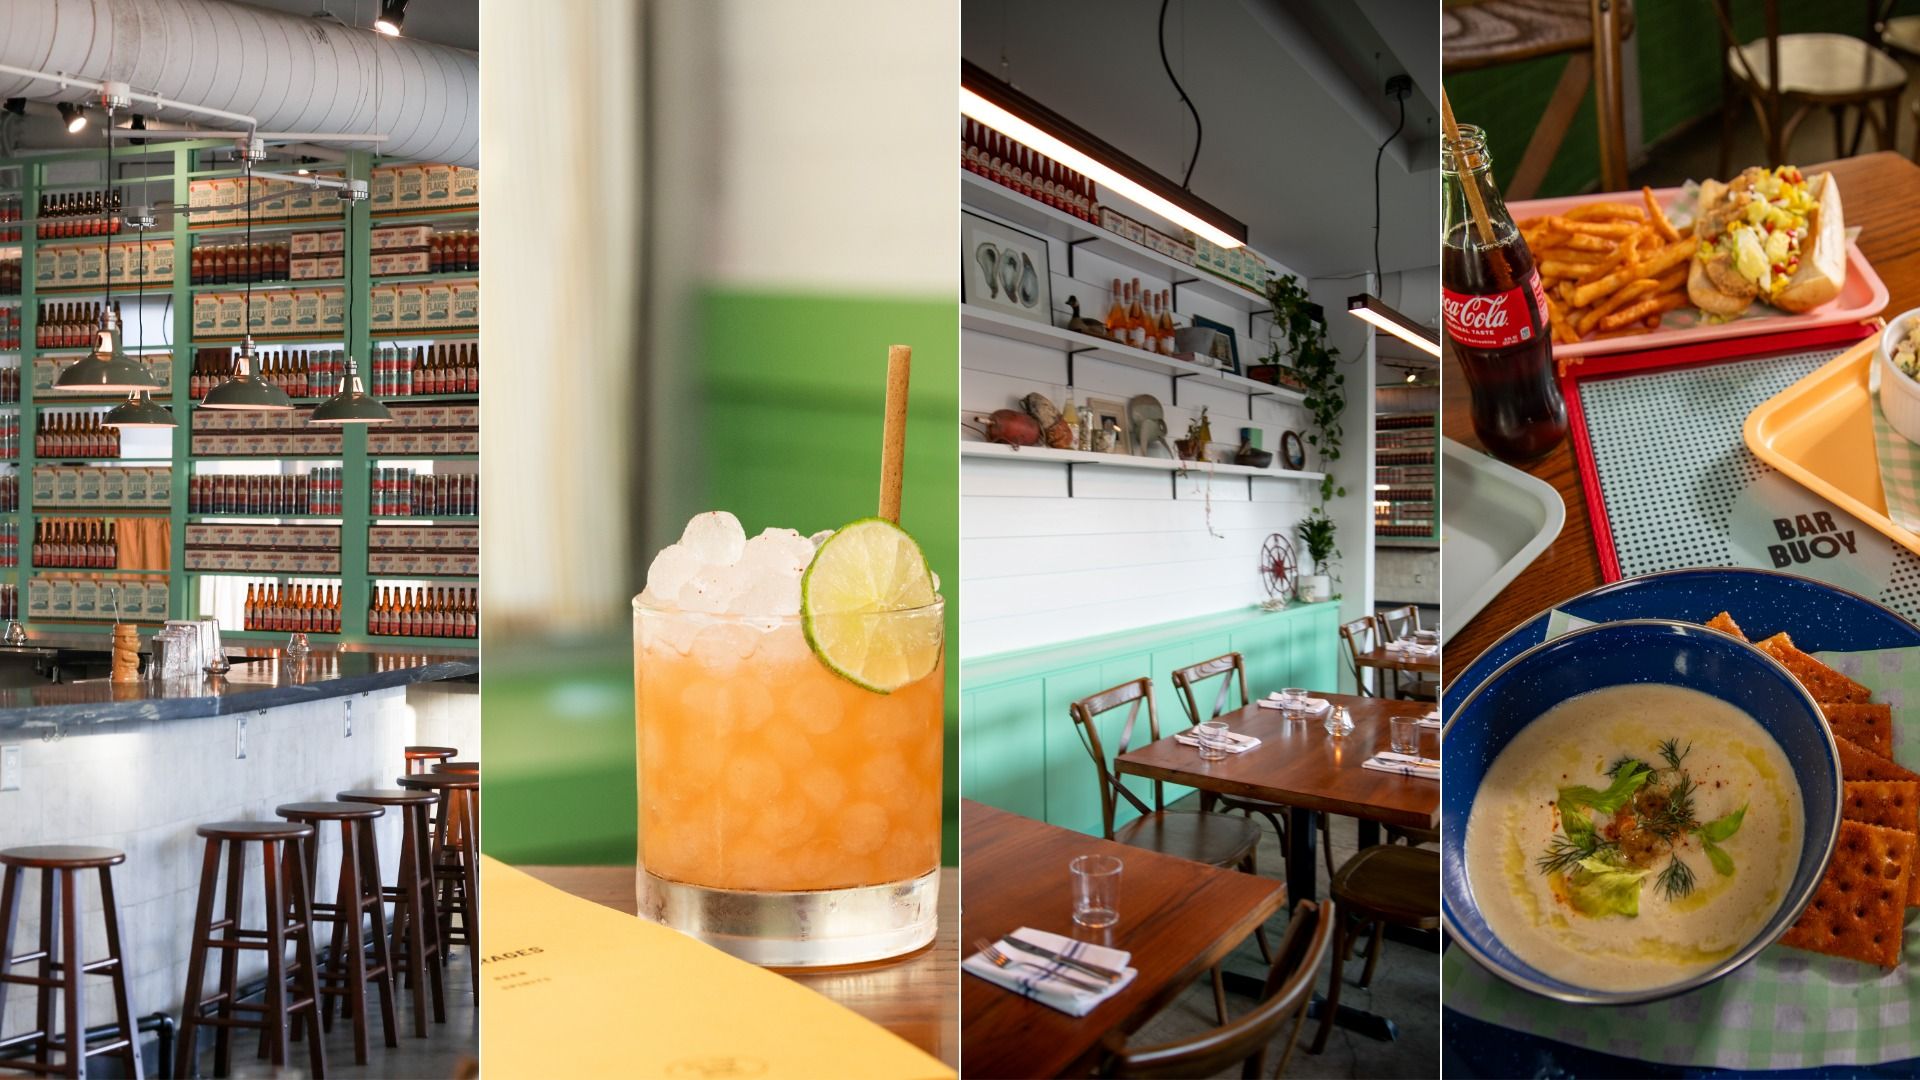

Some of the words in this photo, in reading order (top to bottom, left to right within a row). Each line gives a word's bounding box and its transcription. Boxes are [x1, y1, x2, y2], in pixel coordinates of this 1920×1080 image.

[427, 180, 449, 191] FLAKES
[1442, 293, 1509, 328] ca-Cola
[1773, 511, 1838, 541] BAR
[1767, 530, 1858, 569] BUOY
